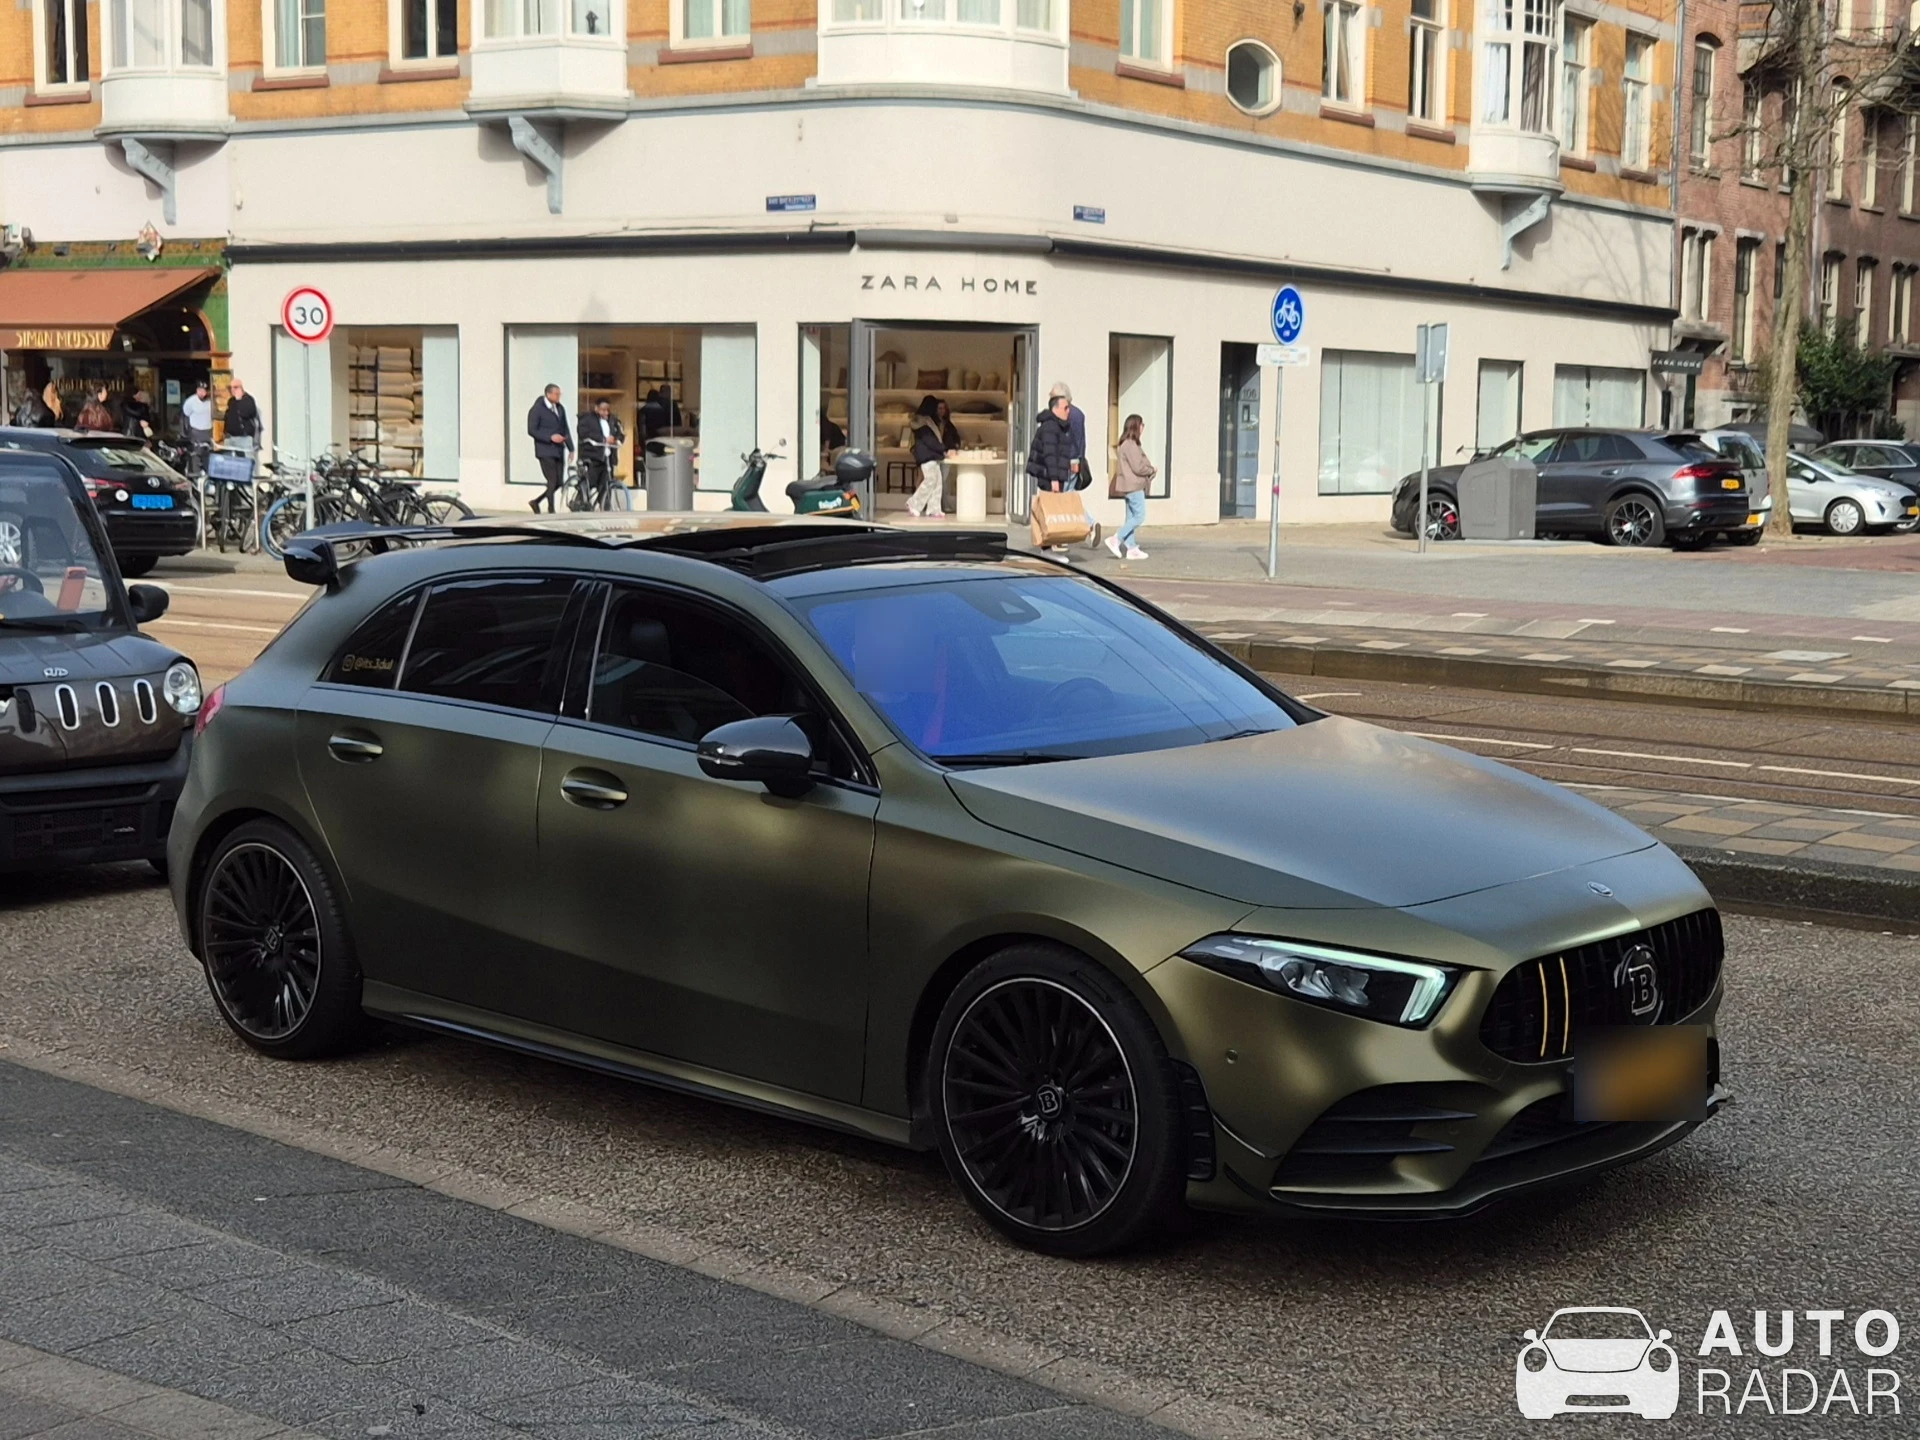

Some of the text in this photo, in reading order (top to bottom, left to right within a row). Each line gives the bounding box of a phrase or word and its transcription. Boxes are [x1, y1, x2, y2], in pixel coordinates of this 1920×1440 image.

[861, 275, 1038, 296] ZARA HOME
[294, 306, 324, 325] 30
[1628, 963, 1658, 1016] B
[1038, 1090, 1059, 1113] B
